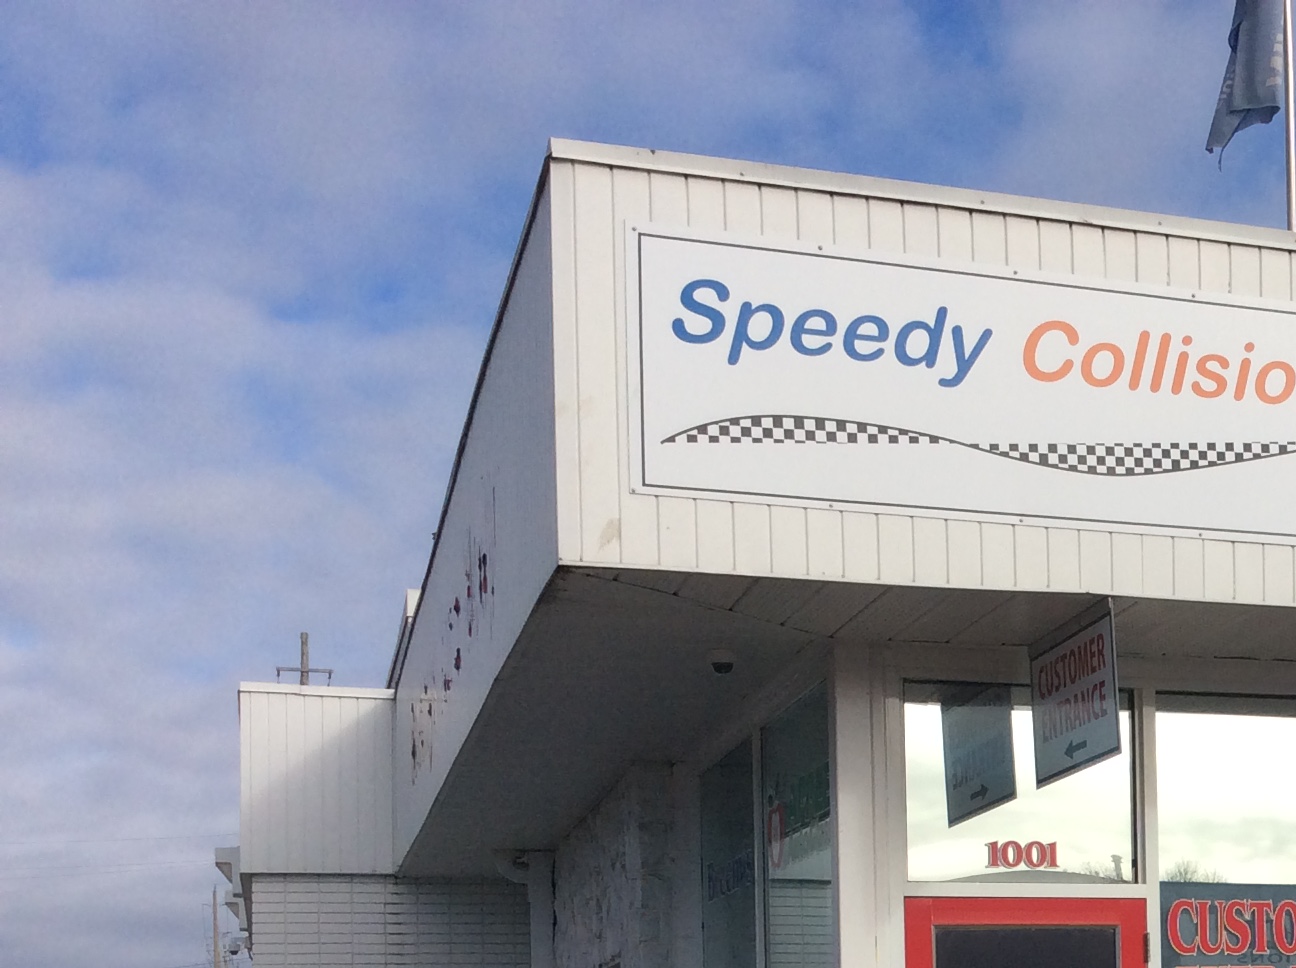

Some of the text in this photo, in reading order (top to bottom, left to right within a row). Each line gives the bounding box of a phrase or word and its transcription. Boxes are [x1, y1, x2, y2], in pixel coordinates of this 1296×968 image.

[672, 279, 992, 388] Speedy
[1038, 633, 1107, 700] CUSTOMER
[1042, 680, 1108, 743] ENTRANCE
[985, 840, 1060, 869] 1001
